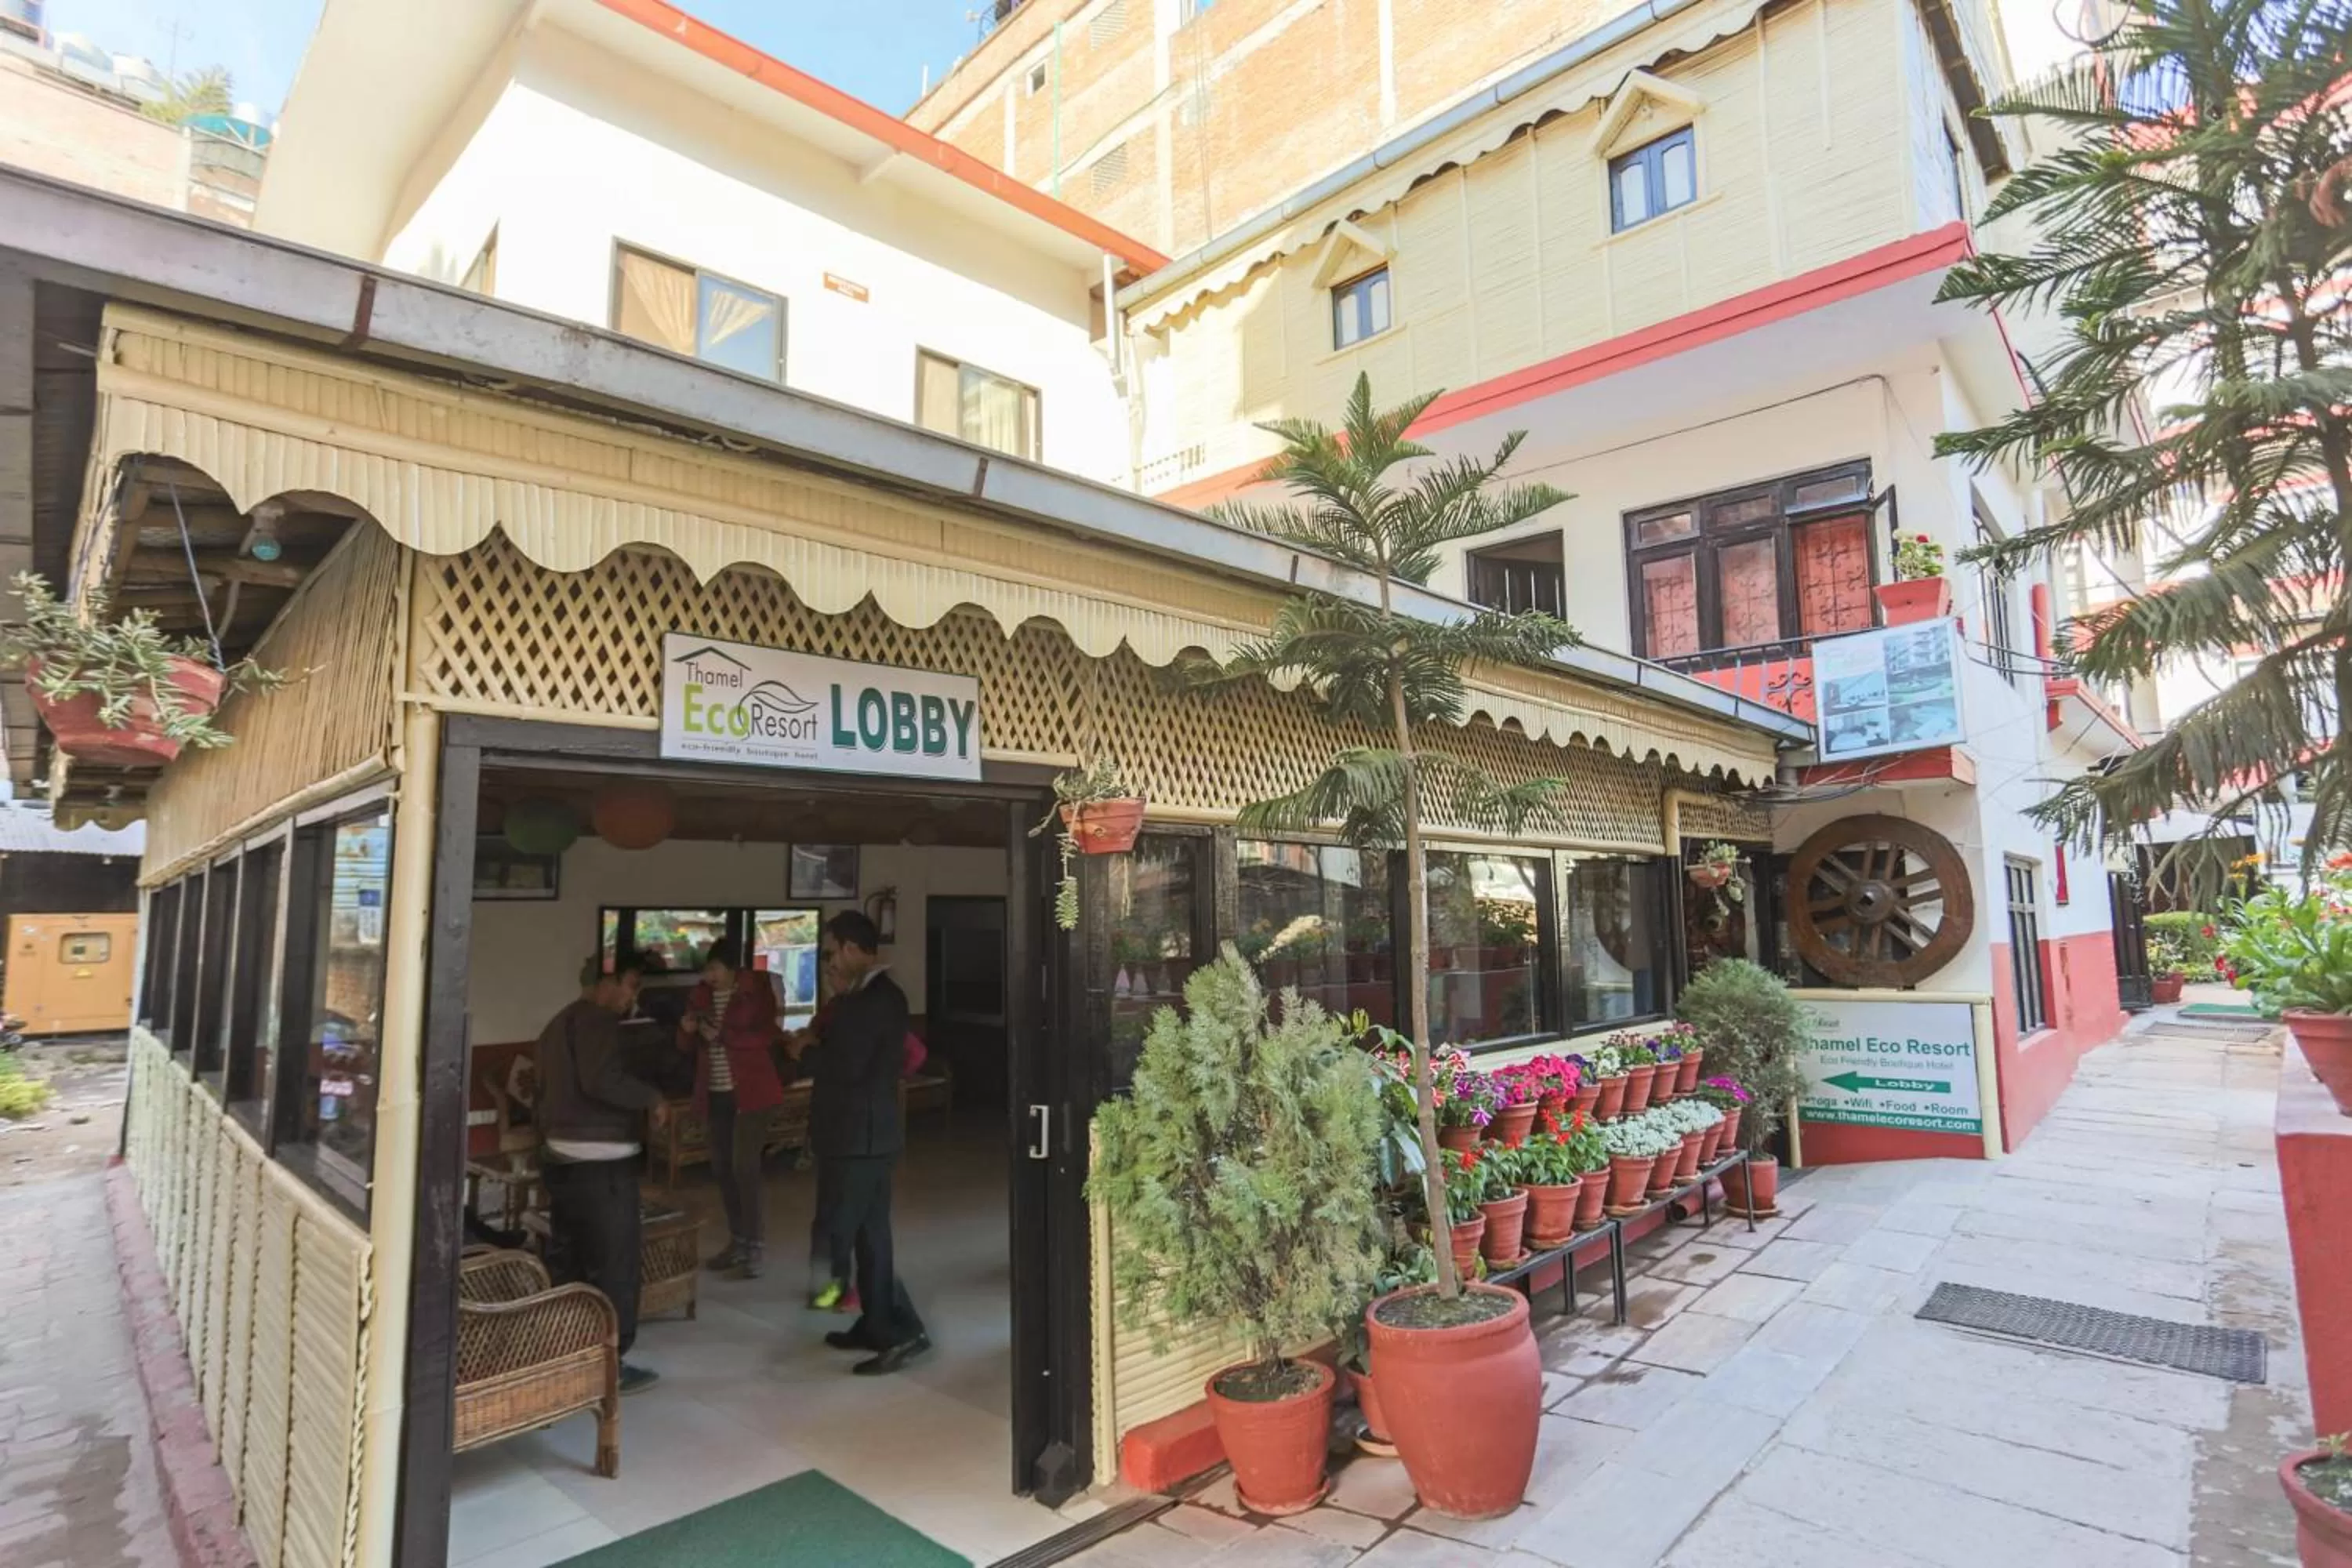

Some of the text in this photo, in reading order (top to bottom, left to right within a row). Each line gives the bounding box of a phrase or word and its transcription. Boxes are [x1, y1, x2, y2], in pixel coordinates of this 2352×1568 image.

[685, 661, 743, 688] Thamel
[684, 683, 818, 740] Eco Resort
[830, 683, 975, 760] LOBBY
[1806, 1035, 1971, 1057] hamel Eco Resort
[1875, 1079, 1936, 1091] Lobby
[1886, 1100, 1917, 1112] Food
[1931, 1103, 1969, 1115] Room
[1806, 1110, 1976, 1130] www.thamelecoresort.com
